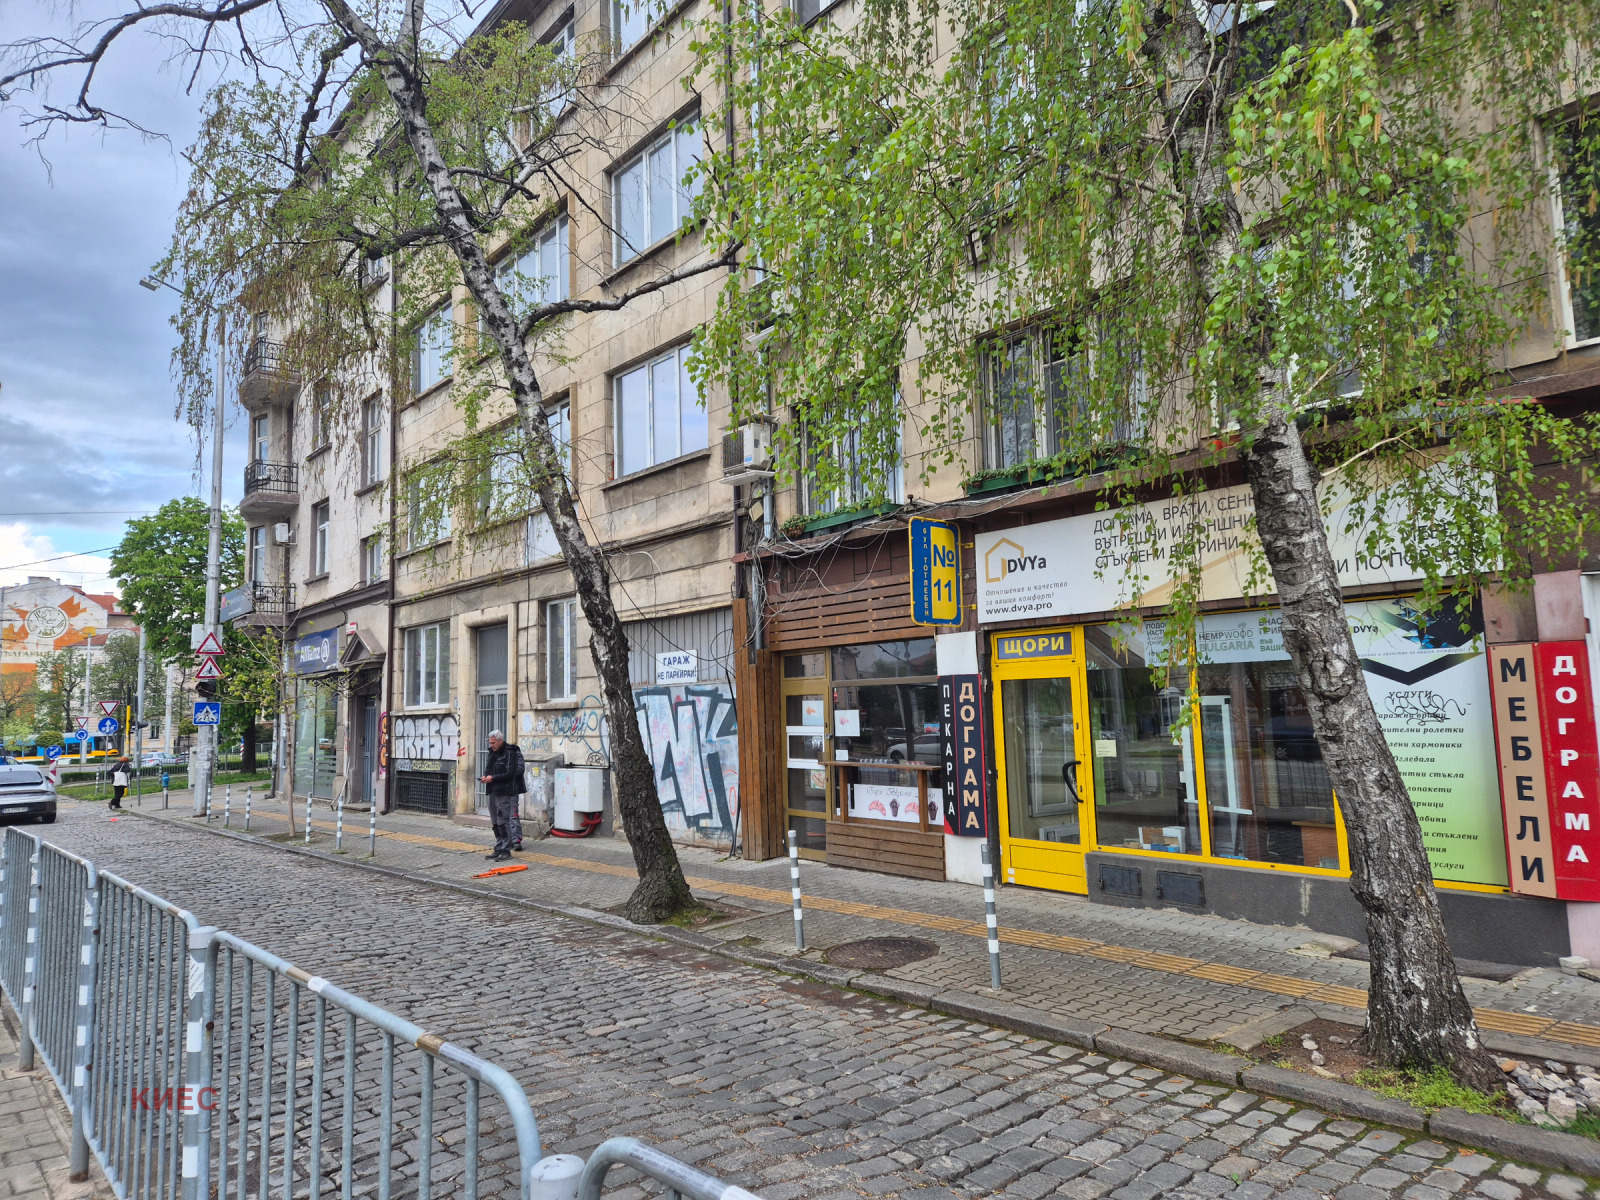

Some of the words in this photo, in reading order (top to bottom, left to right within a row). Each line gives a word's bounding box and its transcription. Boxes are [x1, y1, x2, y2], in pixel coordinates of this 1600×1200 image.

[1163, 501, 1212, 521] ВРАТИ,
[1171, 525, 1181, 539] И
[1007, 555, 1047, 574] DVYa
[1355, 554, 1383, 572] ПО
[933, 578, 953, 603] 11
[1034, 581, 1068, 591] качество
[1018, 592, 1055, 603] комфорт!
[985, 602, 1053, 615] www.dvya.pro
[1004, 636, 1065, 656] ЩОРИ
[1200, 640, 1256, 653] BULGARIA
[1260, 644, 1285, 652] ВАШИ
[300, 645, 321, 663] Allianz
[663, 655, 690, 667] ГАРАЖ
[657, 671, 665, 680] НЕ
[1423, 727, 1464, 735] ролетки
[943, 684, 955, 816] ПЕКАРНА
[959, 682, 980, 829] ДОГРАМА
[1393, 755, 1436, 763] Огледала
[1552, 655, 1590, 863] ДОГРАМА
[1429, 771, 1465, 779] стъкла
[1500, 657, 1545, 883] МЕБЕЛИ
[1417, 815, 1447, 823] абини
[1431, 832, 1478, 840] стъклени
[1434, 861, 1465, 870] услуги
